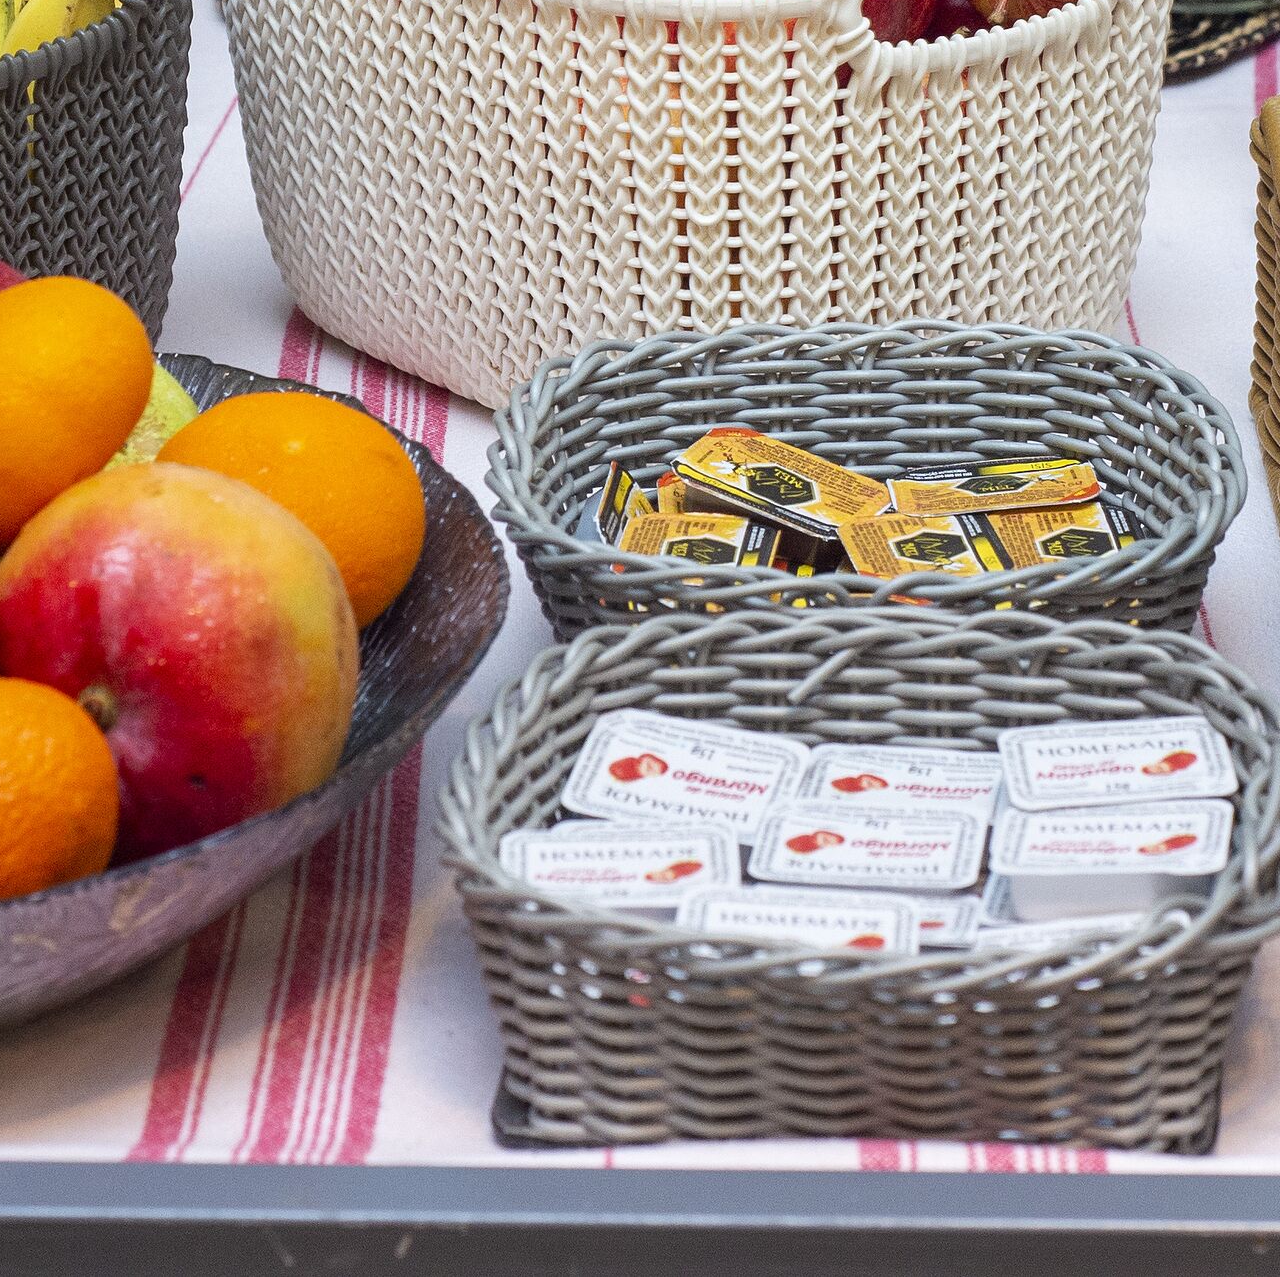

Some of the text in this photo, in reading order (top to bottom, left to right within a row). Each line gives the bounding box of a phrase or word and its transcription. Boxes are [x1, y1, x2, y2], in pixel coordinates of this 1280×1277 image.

[1035, 738, 1191, 758] HOMEMADE
[672, 769, 769, 796] Morango
[605, 786, 751, 823] HOMEMADE
[1039, 821, 1193, 835] HOMEMADE
[539, 847, 695, 862] HOMEMADE
